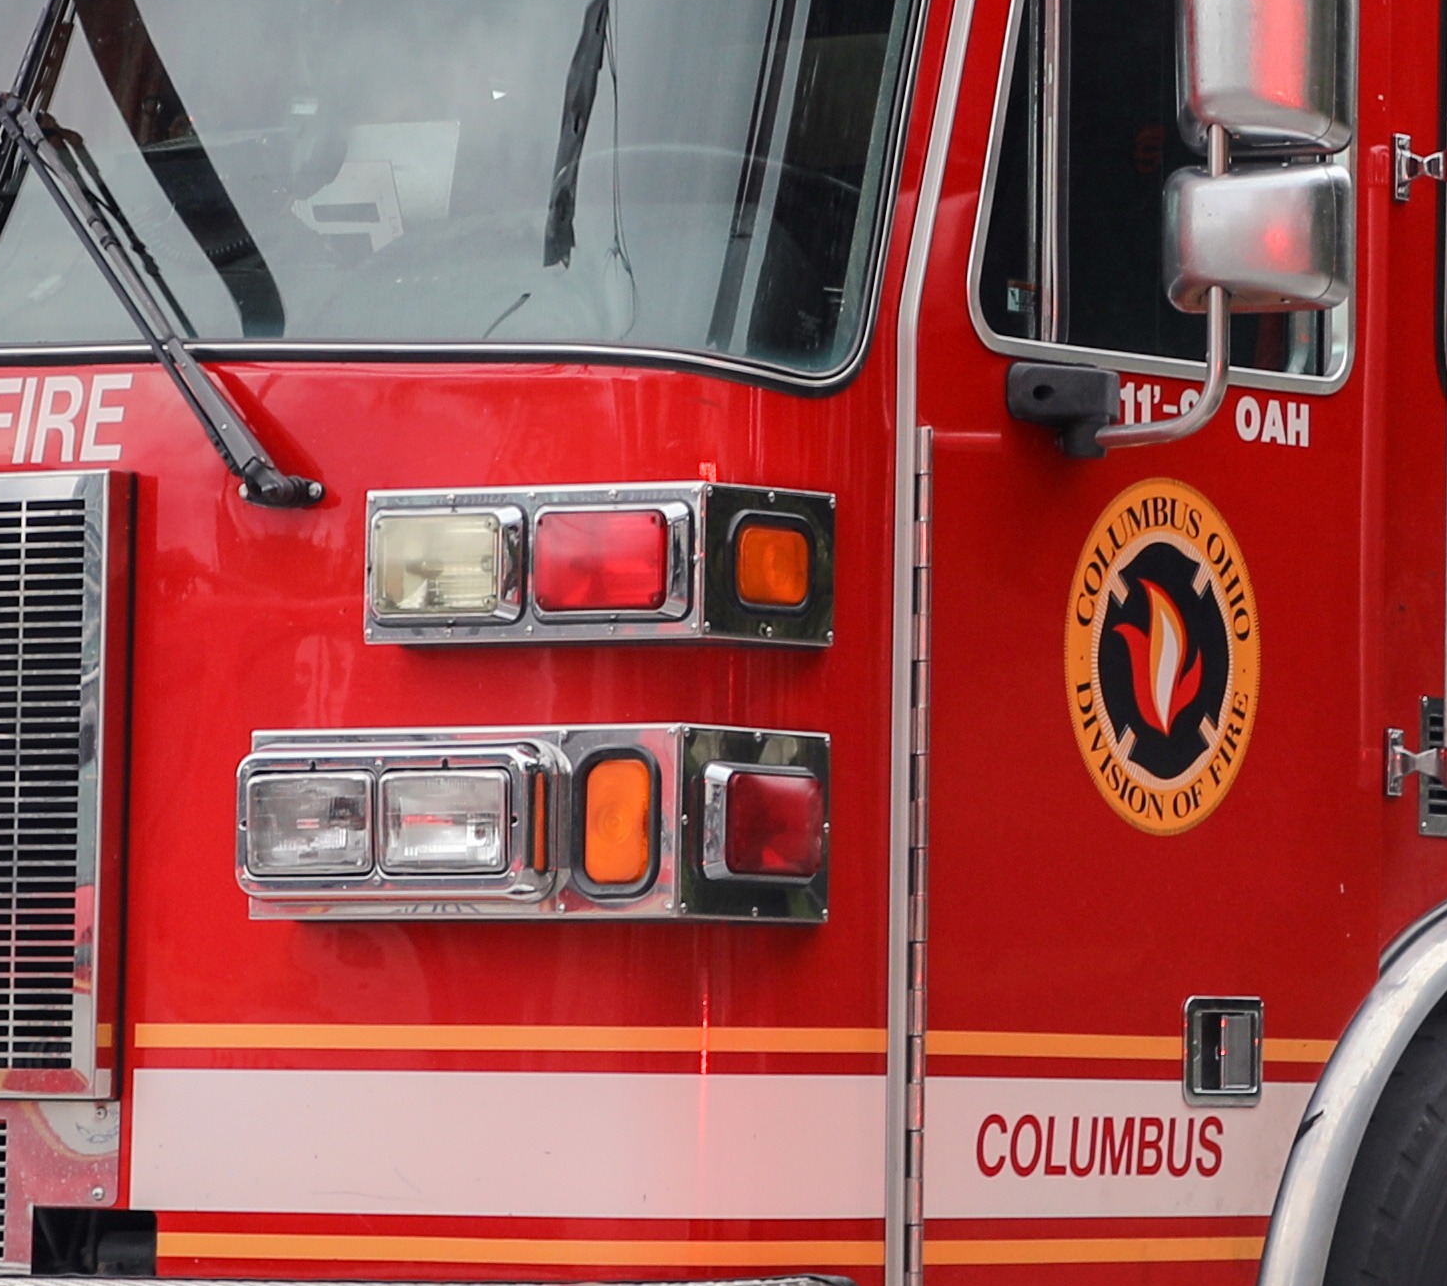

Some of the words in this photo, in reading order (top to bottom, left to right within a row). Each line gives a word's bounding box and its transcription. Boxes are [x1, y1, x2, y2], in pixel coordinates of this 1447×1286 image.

[1235, 395, 1310, 448] OAH
[1075, 496, 1203, 628] COLUMBUS
[1205, 531, 1252, 642] OHIO
[1075, 681, 1165, 821] DIVISION
[1171, 779, 1204, 820] OF
[1209, 692, 1250, 789] FIRE
[975, 1113, 1225, 1178] COLUMBUS
